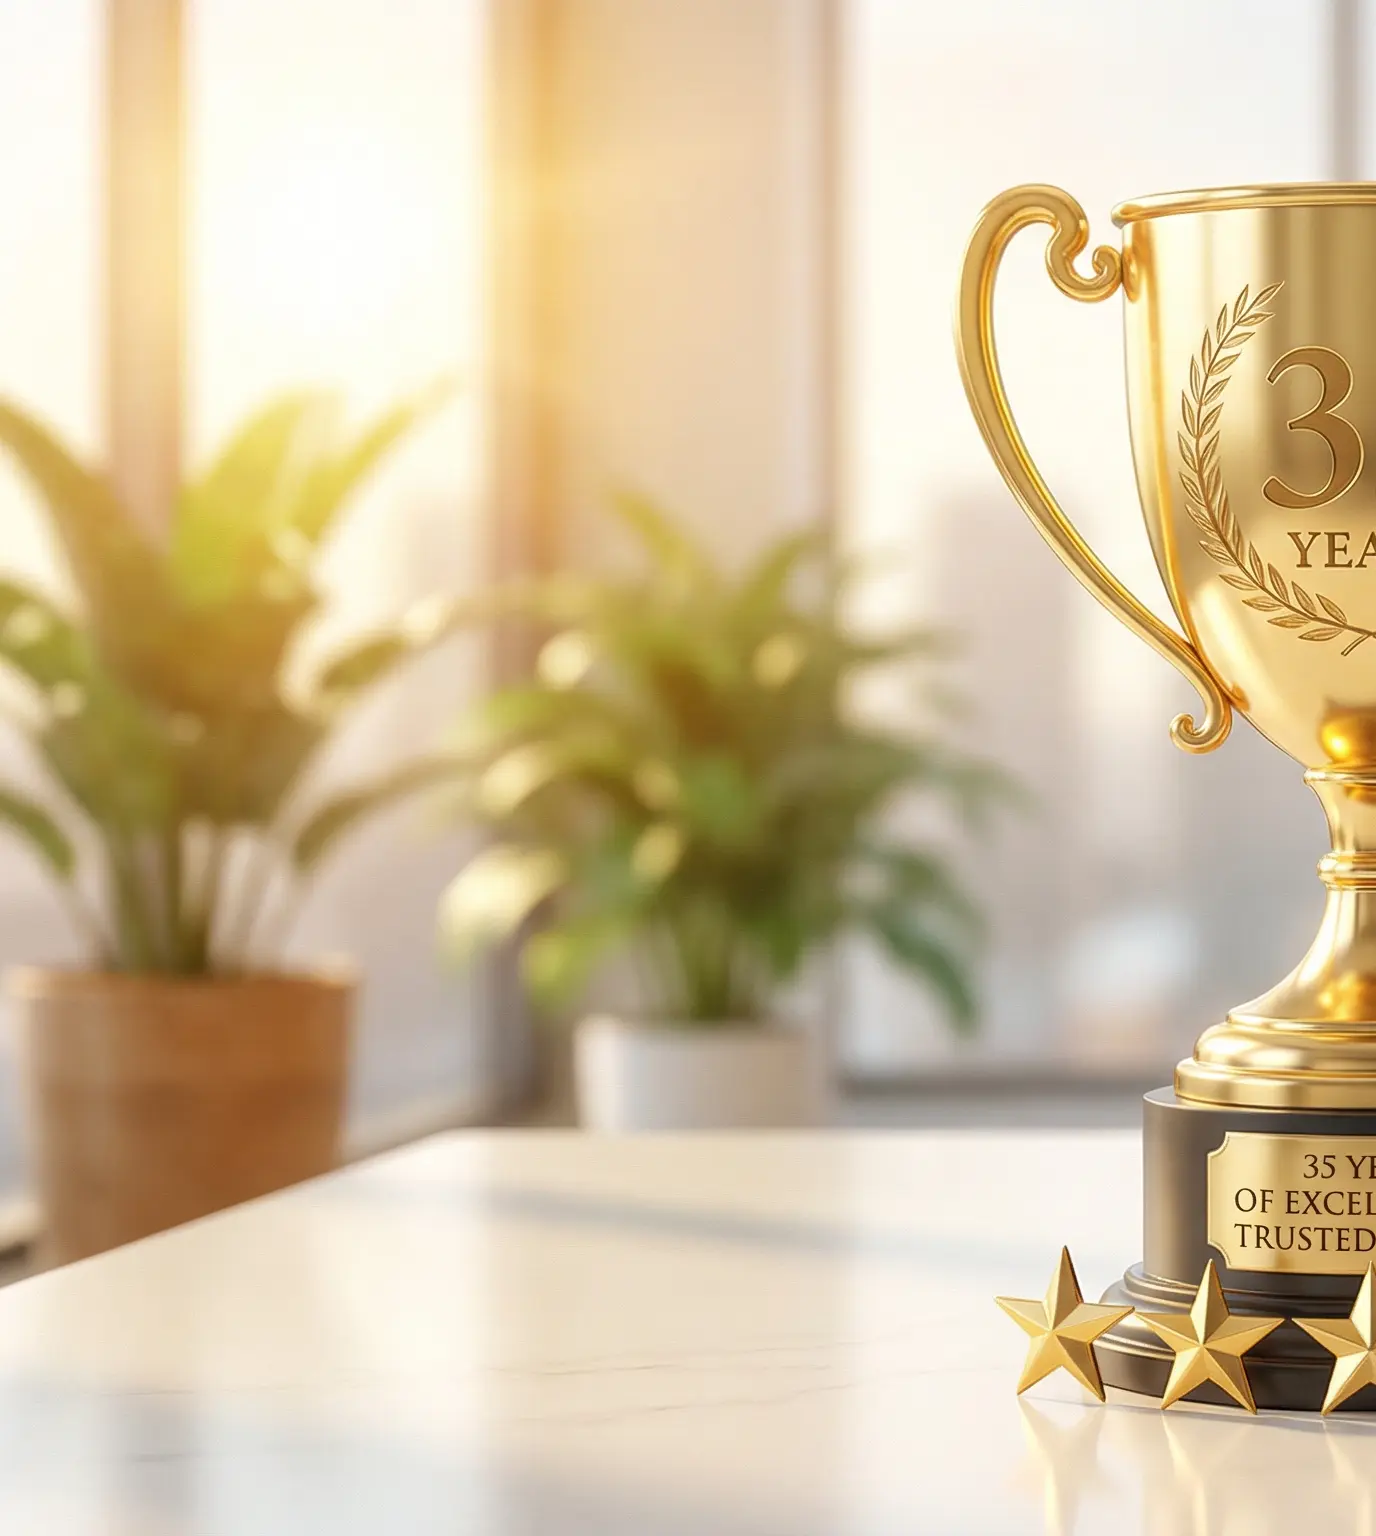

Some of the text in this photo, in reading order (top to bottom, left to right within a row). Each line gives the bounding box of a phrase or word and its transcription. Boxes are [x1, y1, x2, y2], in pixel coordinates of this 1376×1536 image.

[1303, 1154, 1336, 1180] 35
[1234, 1187, 1274, 1215] OF
[1234, 1223, 1376, 1253] TRUSTED
